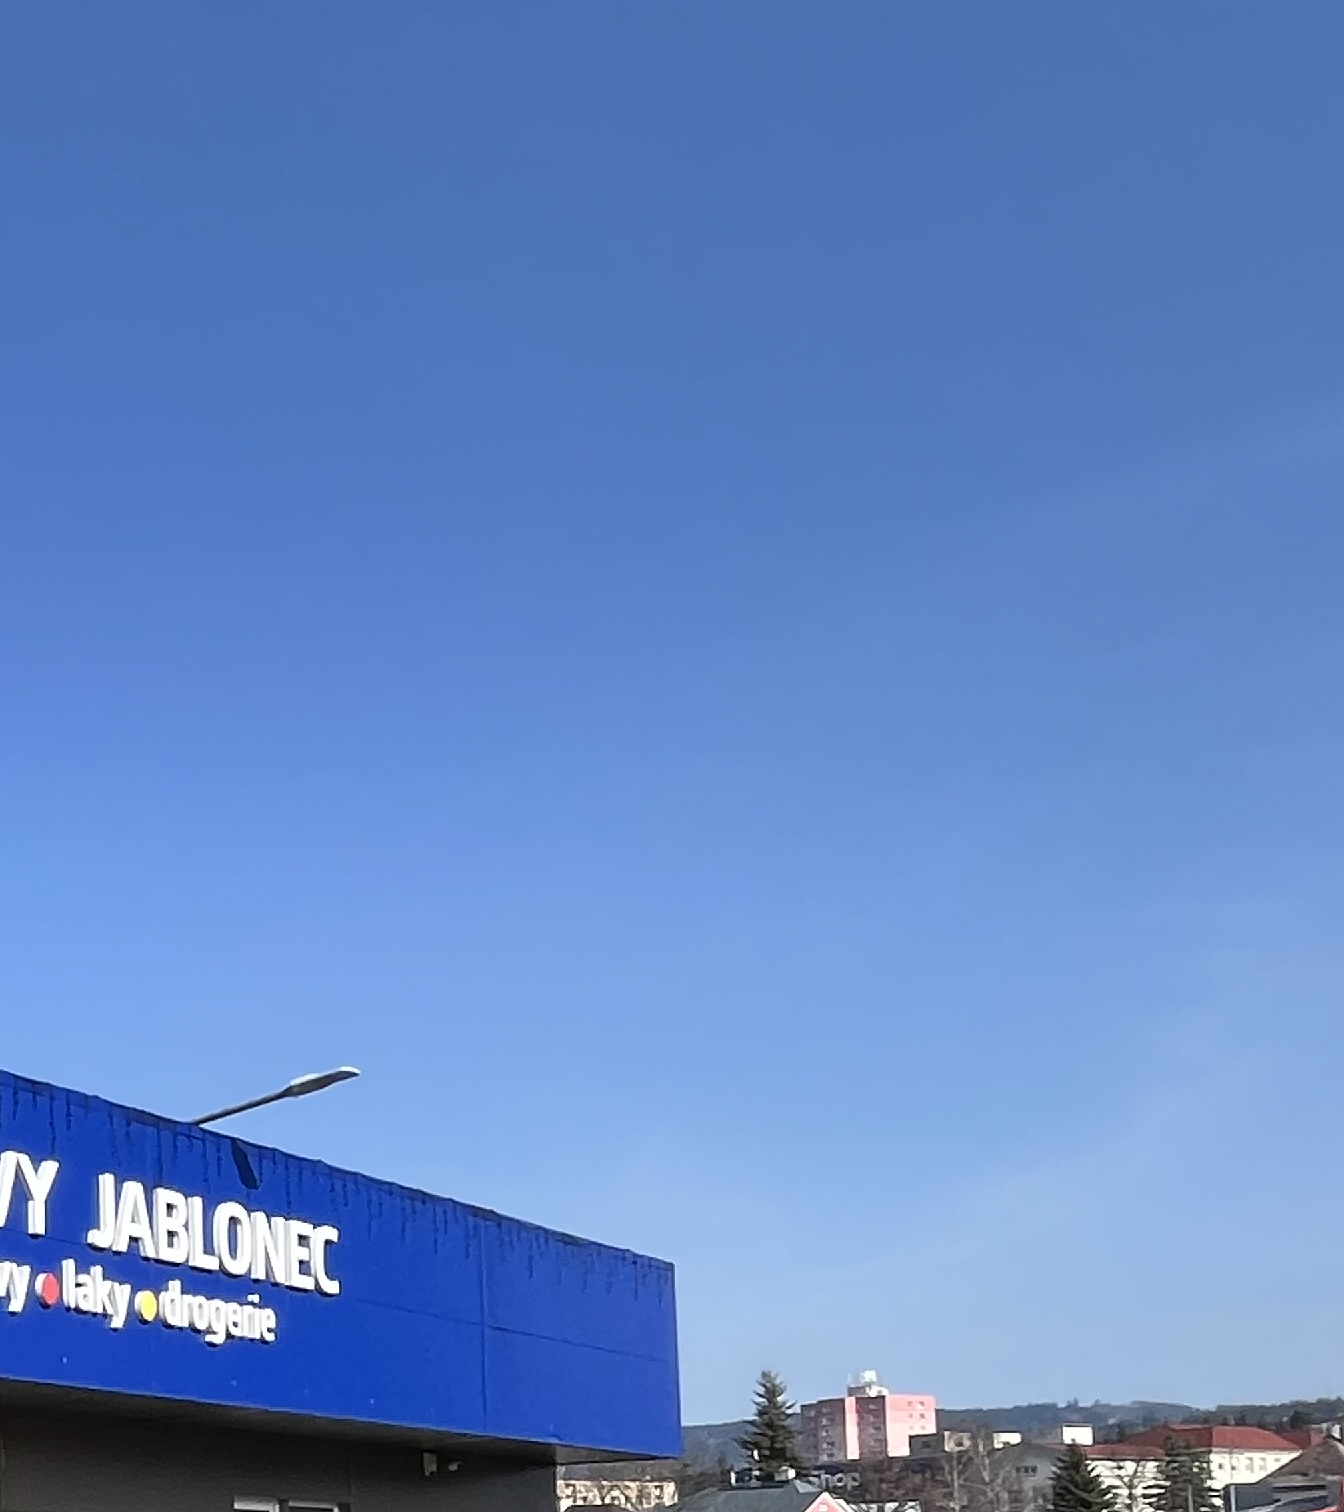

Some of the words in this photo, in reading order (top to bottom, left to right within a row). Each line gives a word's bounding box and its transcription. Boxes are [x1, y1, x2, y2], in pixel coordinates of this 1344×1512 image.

[86, 1173, 341, 1295] JABLONEC
[61, 1258, 132, 1329] laky
[160, 1279, 277, 1345] drogerie
